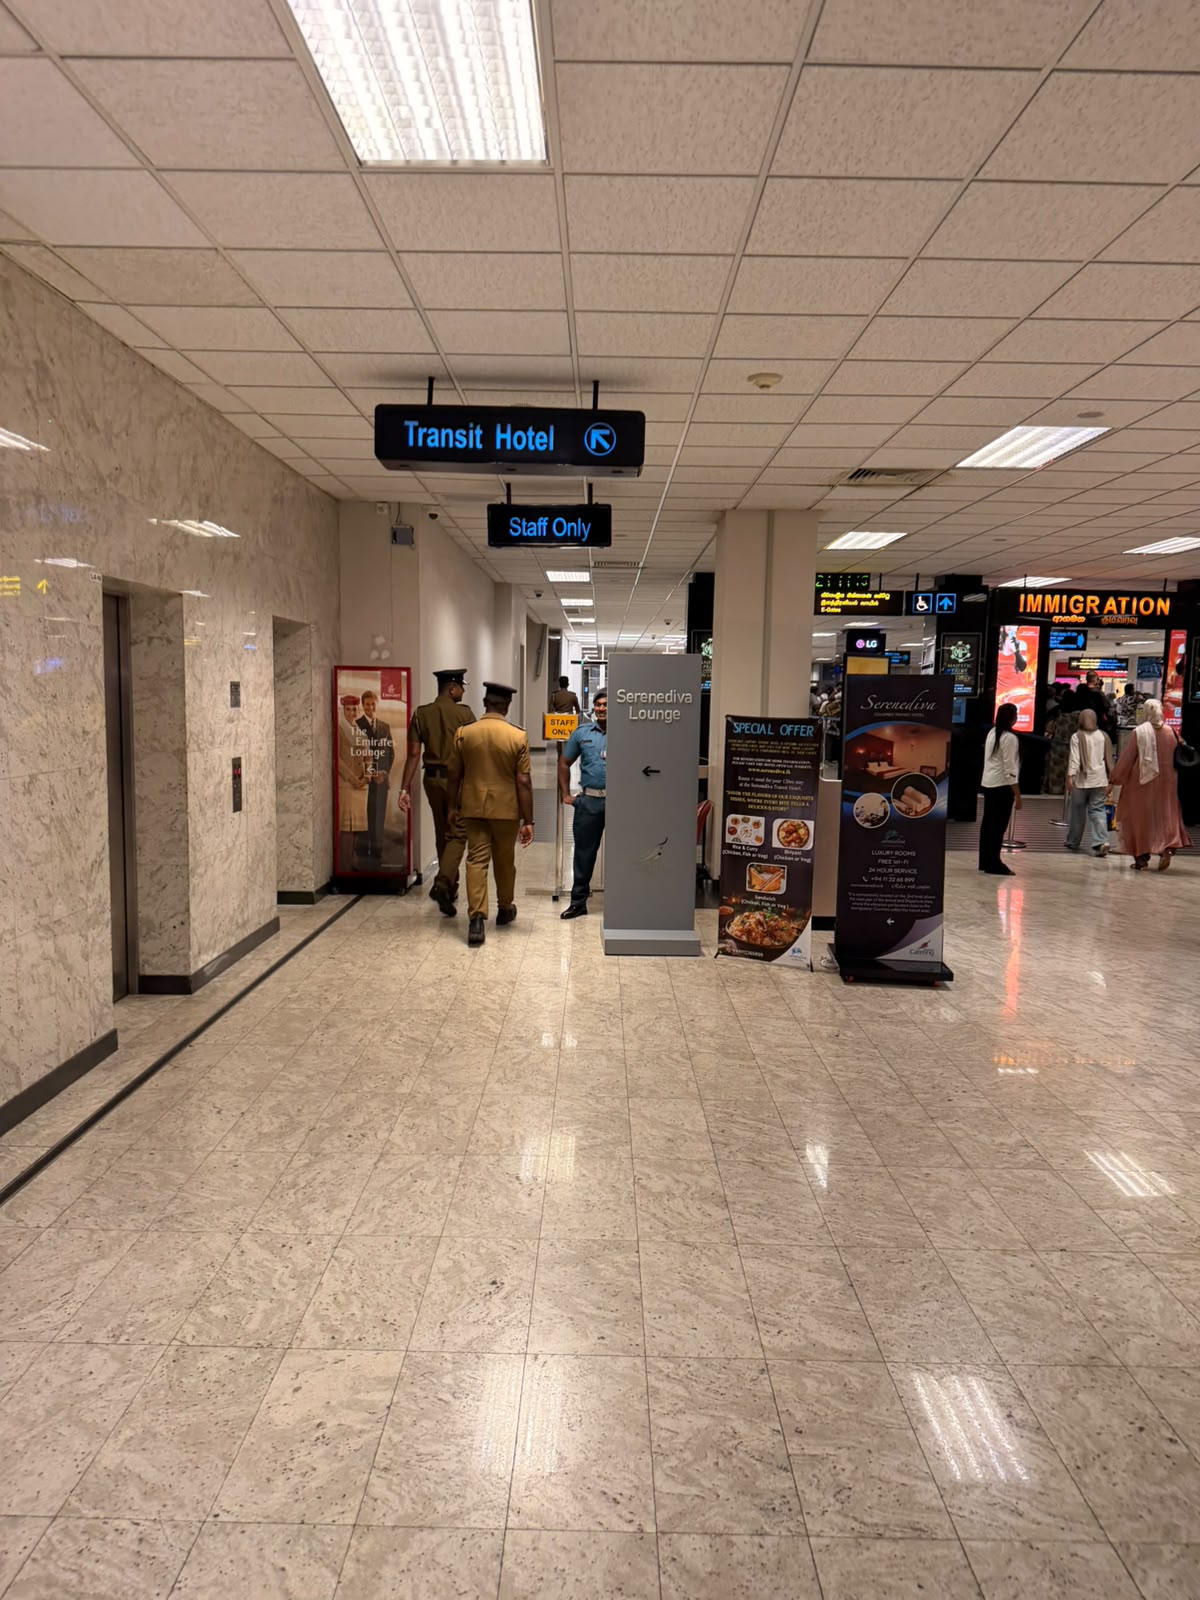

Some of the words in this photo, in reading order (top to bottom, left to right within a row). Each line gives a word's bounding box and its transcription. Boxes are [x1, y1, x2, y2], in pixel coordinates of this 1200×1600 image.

[403, 419, 483, 448] Transit
[495, 423, 554, 451] Hotel
[509, 516, 548, 537] Staff
[552, 517, 592, 542] Only
[1018, 593, 1171, 616] IMMIGRATION
[865, 640, 878, 648] LG
[616, 688, 693, 704] Serenediva
[860, 689, 937, 711] Serenediva
[550, 718, 575, 727] STAFF
[629, 706, 681, 724] Lounge
[350, 727, 367, 736] The
[551, 728, 573, 736] ONLY
[732, 722, 775, 736] SPECIAL
[779, 724, 815, 737] OFFER
[350, 747, 386, 760] Lounge
